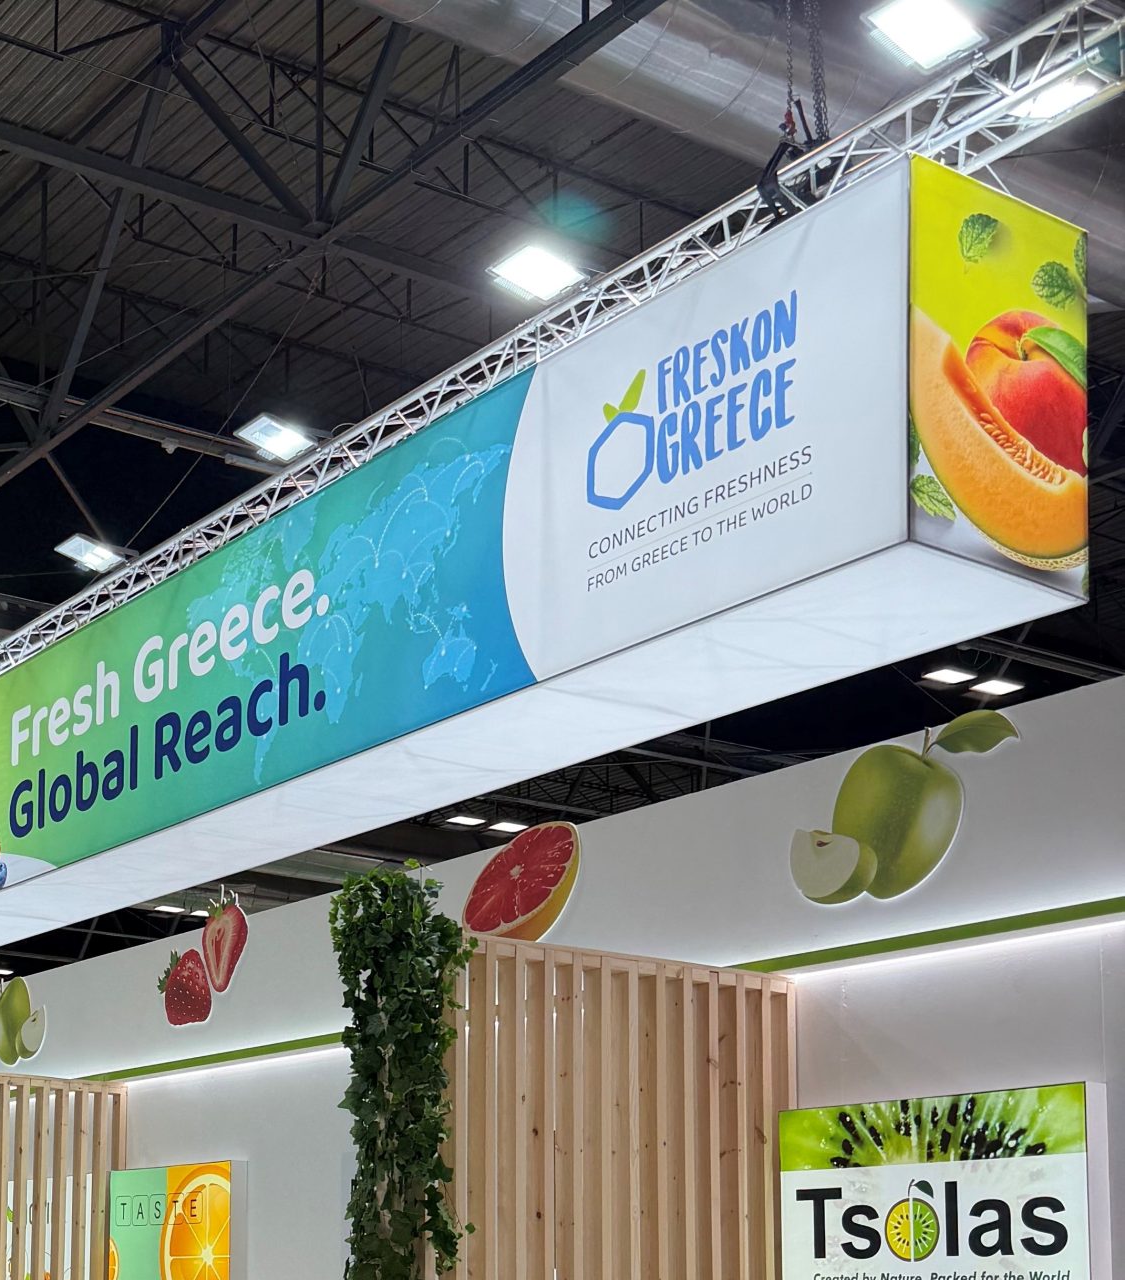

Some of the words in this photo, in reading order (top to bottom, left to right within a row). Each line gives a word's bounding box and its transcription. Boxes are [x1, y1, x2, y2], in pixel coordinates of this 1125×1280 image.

[657, 290, 797, 414] FRESKON
[656, 358, 797, 484] GREECE
[587, 563, 627, 592] FROM
[631, 536, 688, 572] GREECE
[692, 526, 713, 546] TO
[716, 511, 747, 536] THE
[751, 483, 813, 521] WORLD
[588, 496, 699, 559] CONNECTING
[704, 445, 812, 508] FRESHNESS
[10, 660, 119, 767] Fresh
[133, 569, 330, 703] Greece.
[9, 725, 139, 838] Global
[154, 652, 326, 780] Reach.
[120, 1199, 197, 1220] TASTE
[796, 1179, 1069, 1262] Tsolas
